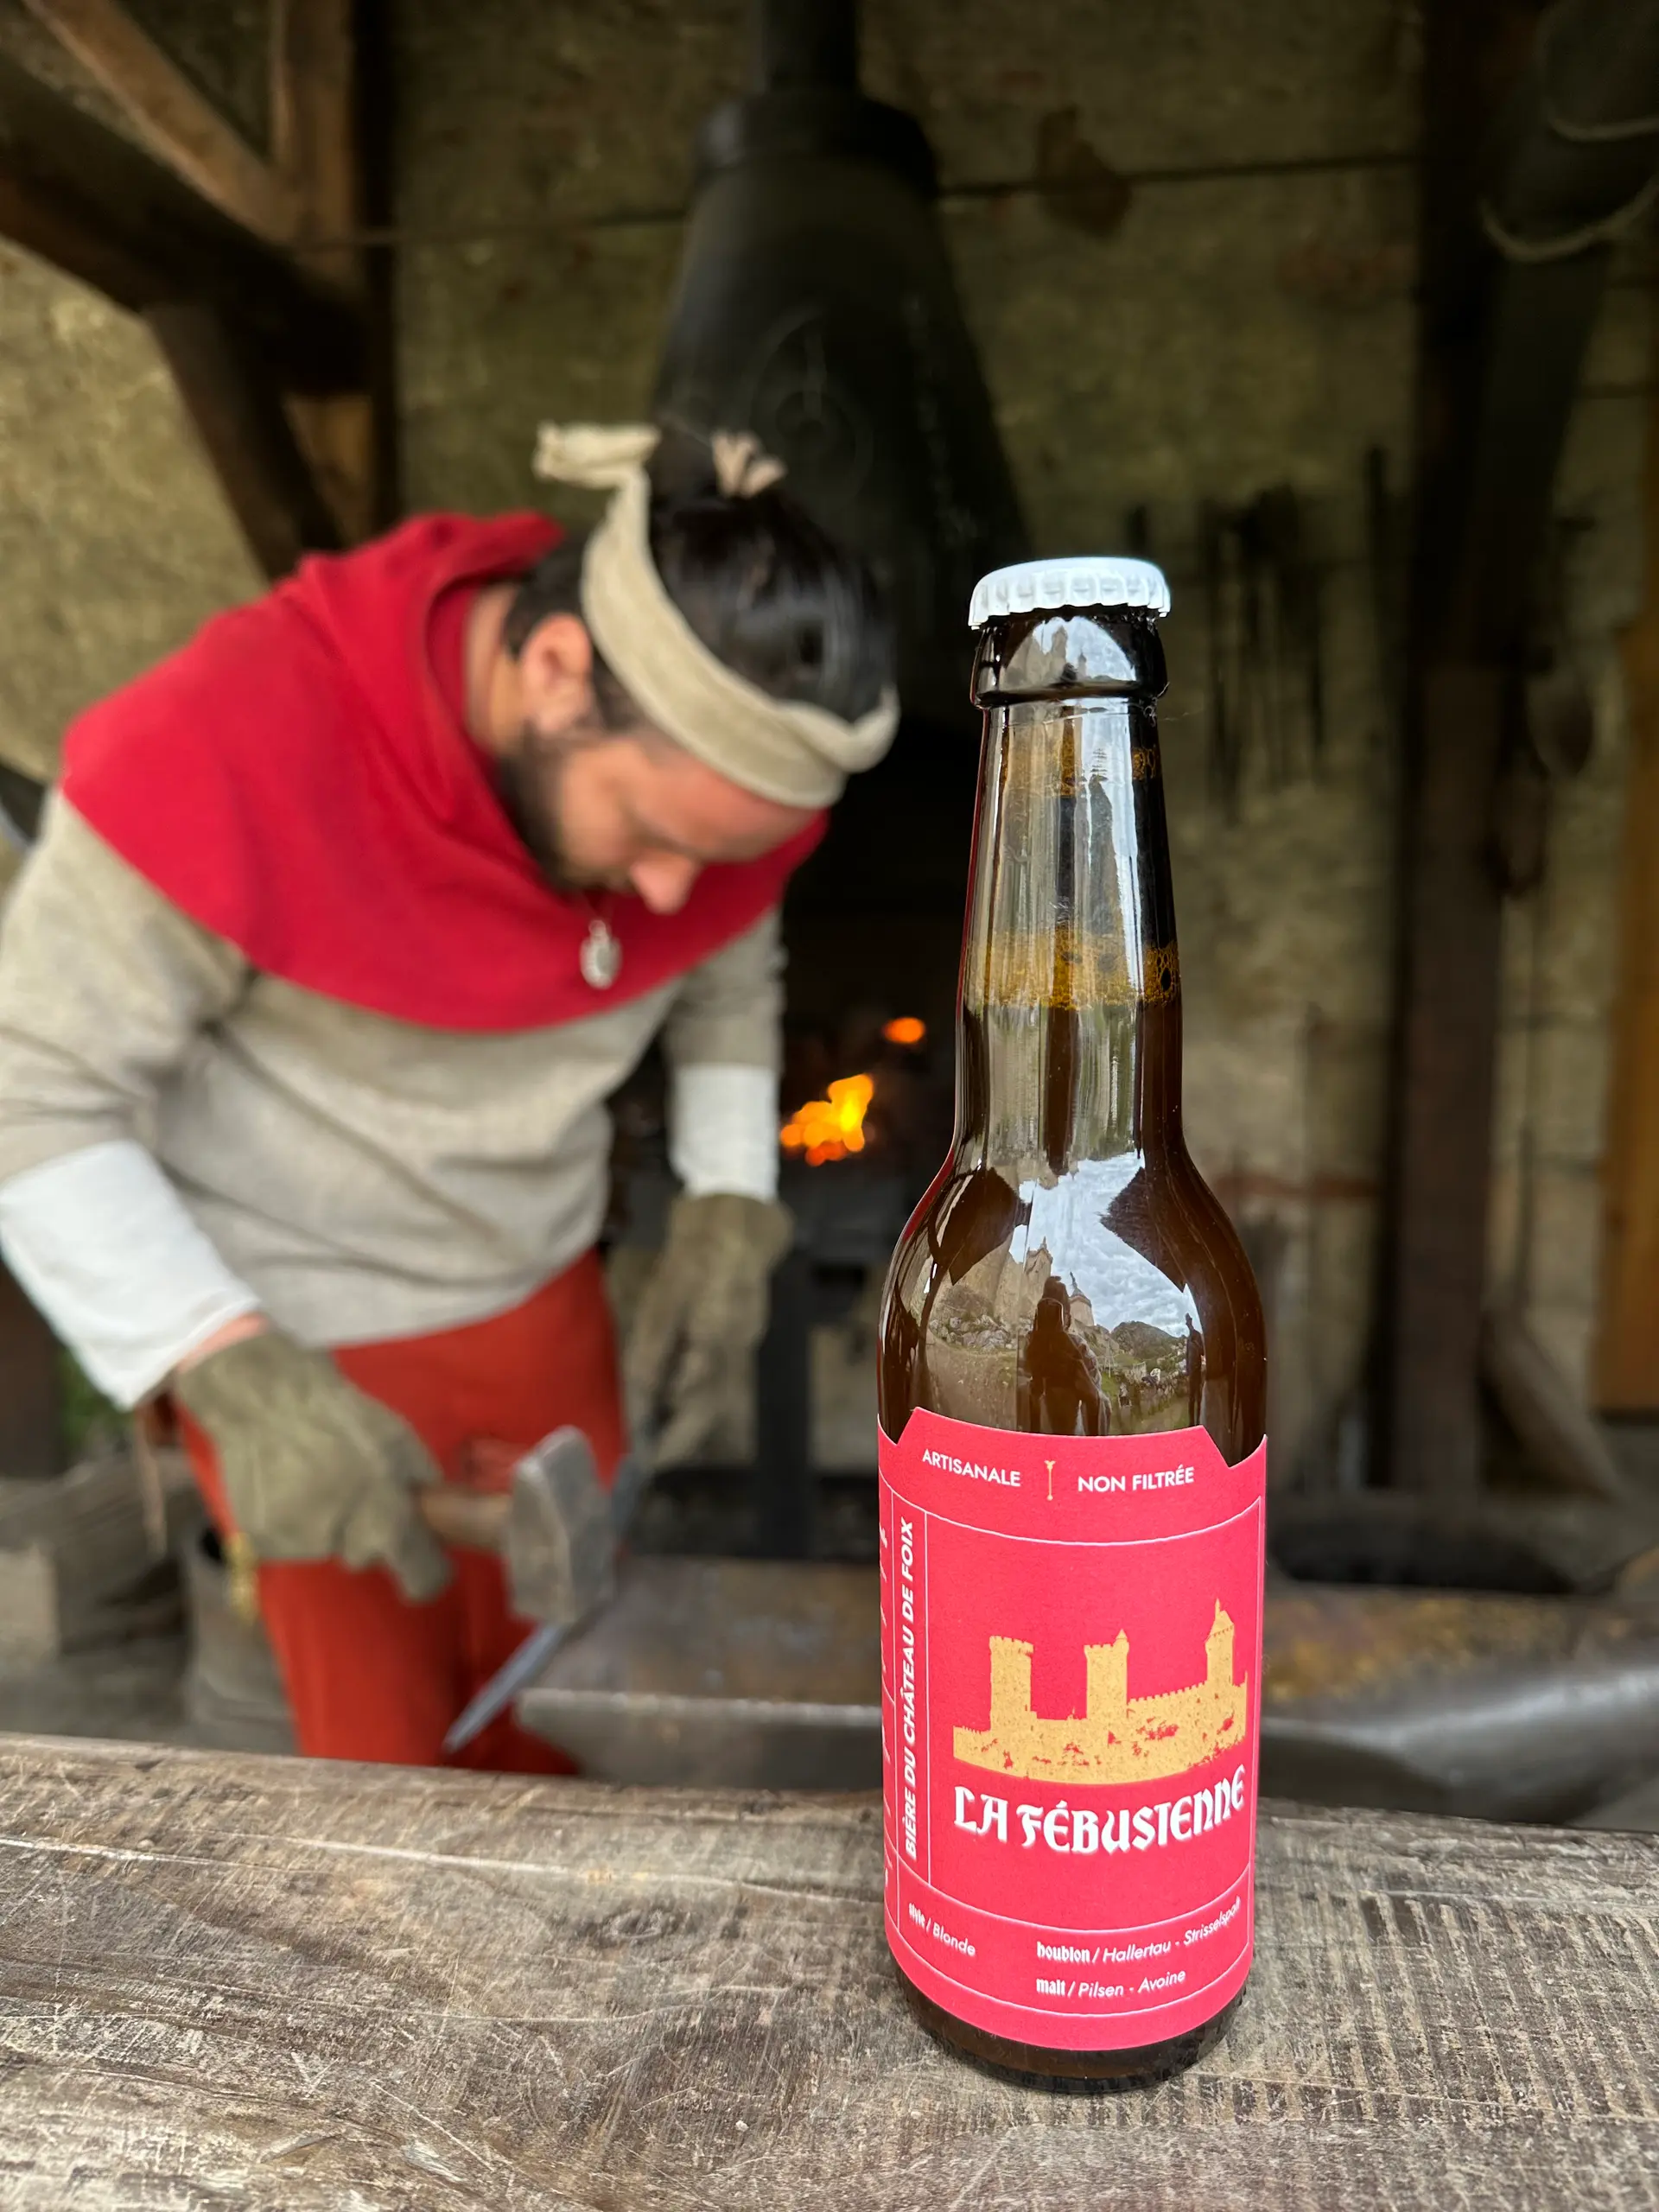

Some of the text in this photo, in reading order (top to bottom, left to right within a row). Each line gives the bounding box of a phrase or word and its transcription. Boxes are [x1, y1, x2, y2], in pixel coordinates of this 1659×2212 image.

[922, 1448, 1021, 1488] ARTISANALE
[1077, 1464, 1195, 1493] NON FILTRÉE
[899, 1516, 917, 1861] BIÈRE DU CHÂTEAU DE FOIX
[954, 1785, 1009, 1844] LA
[933, 1922, 976, 1957] Blonde
[1037, 1941, 1090, 1964] houblon
[1103, 1941, 1171, 1964] Hallertau
[1036, 1978, 1065, 1996] malt
[1078, 1980, 1124, 1999] Pilsen
[1137, 1970, 1186, 1993] Avoine
